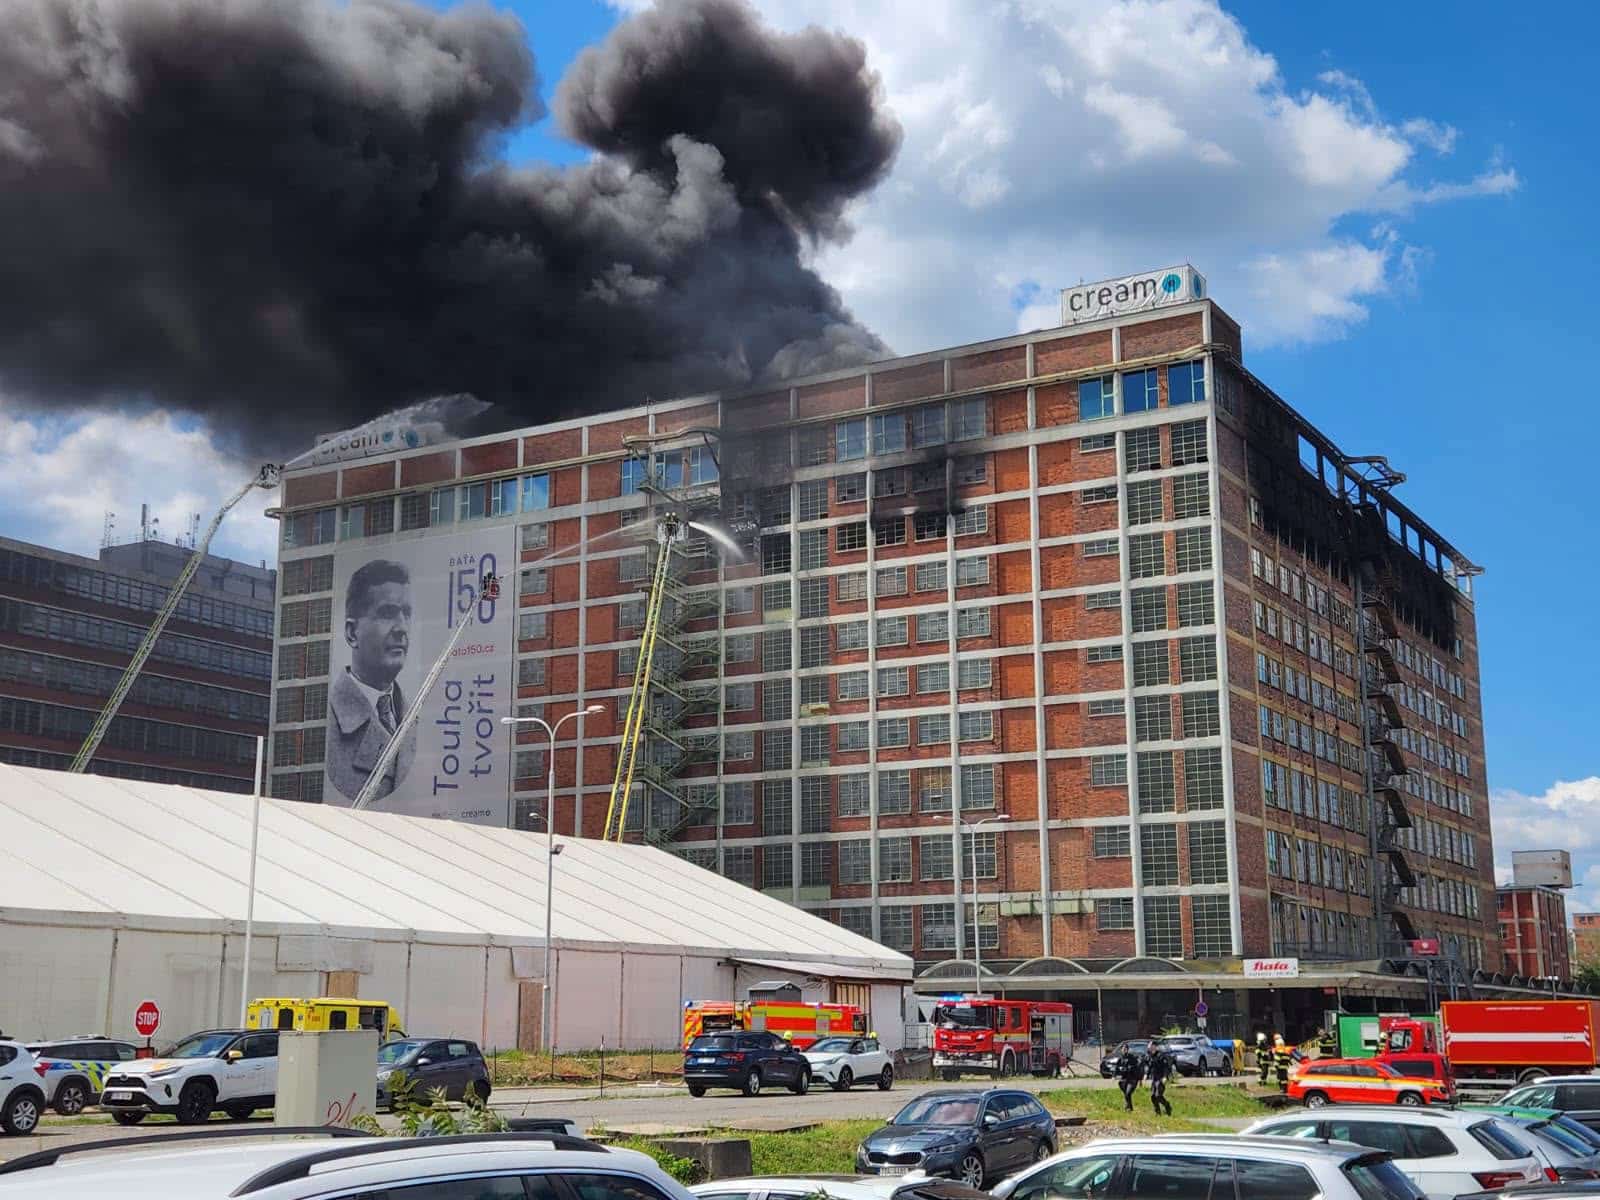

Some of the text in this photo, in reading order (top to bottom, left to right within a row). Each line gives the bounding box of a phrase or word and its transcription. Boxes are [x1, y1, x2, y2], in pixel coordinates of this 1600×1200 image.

[433, 680, 462, 796] Touha
[468, 674, 494, 778] tvořit
[138, 1011, 158, 1026] STOP
